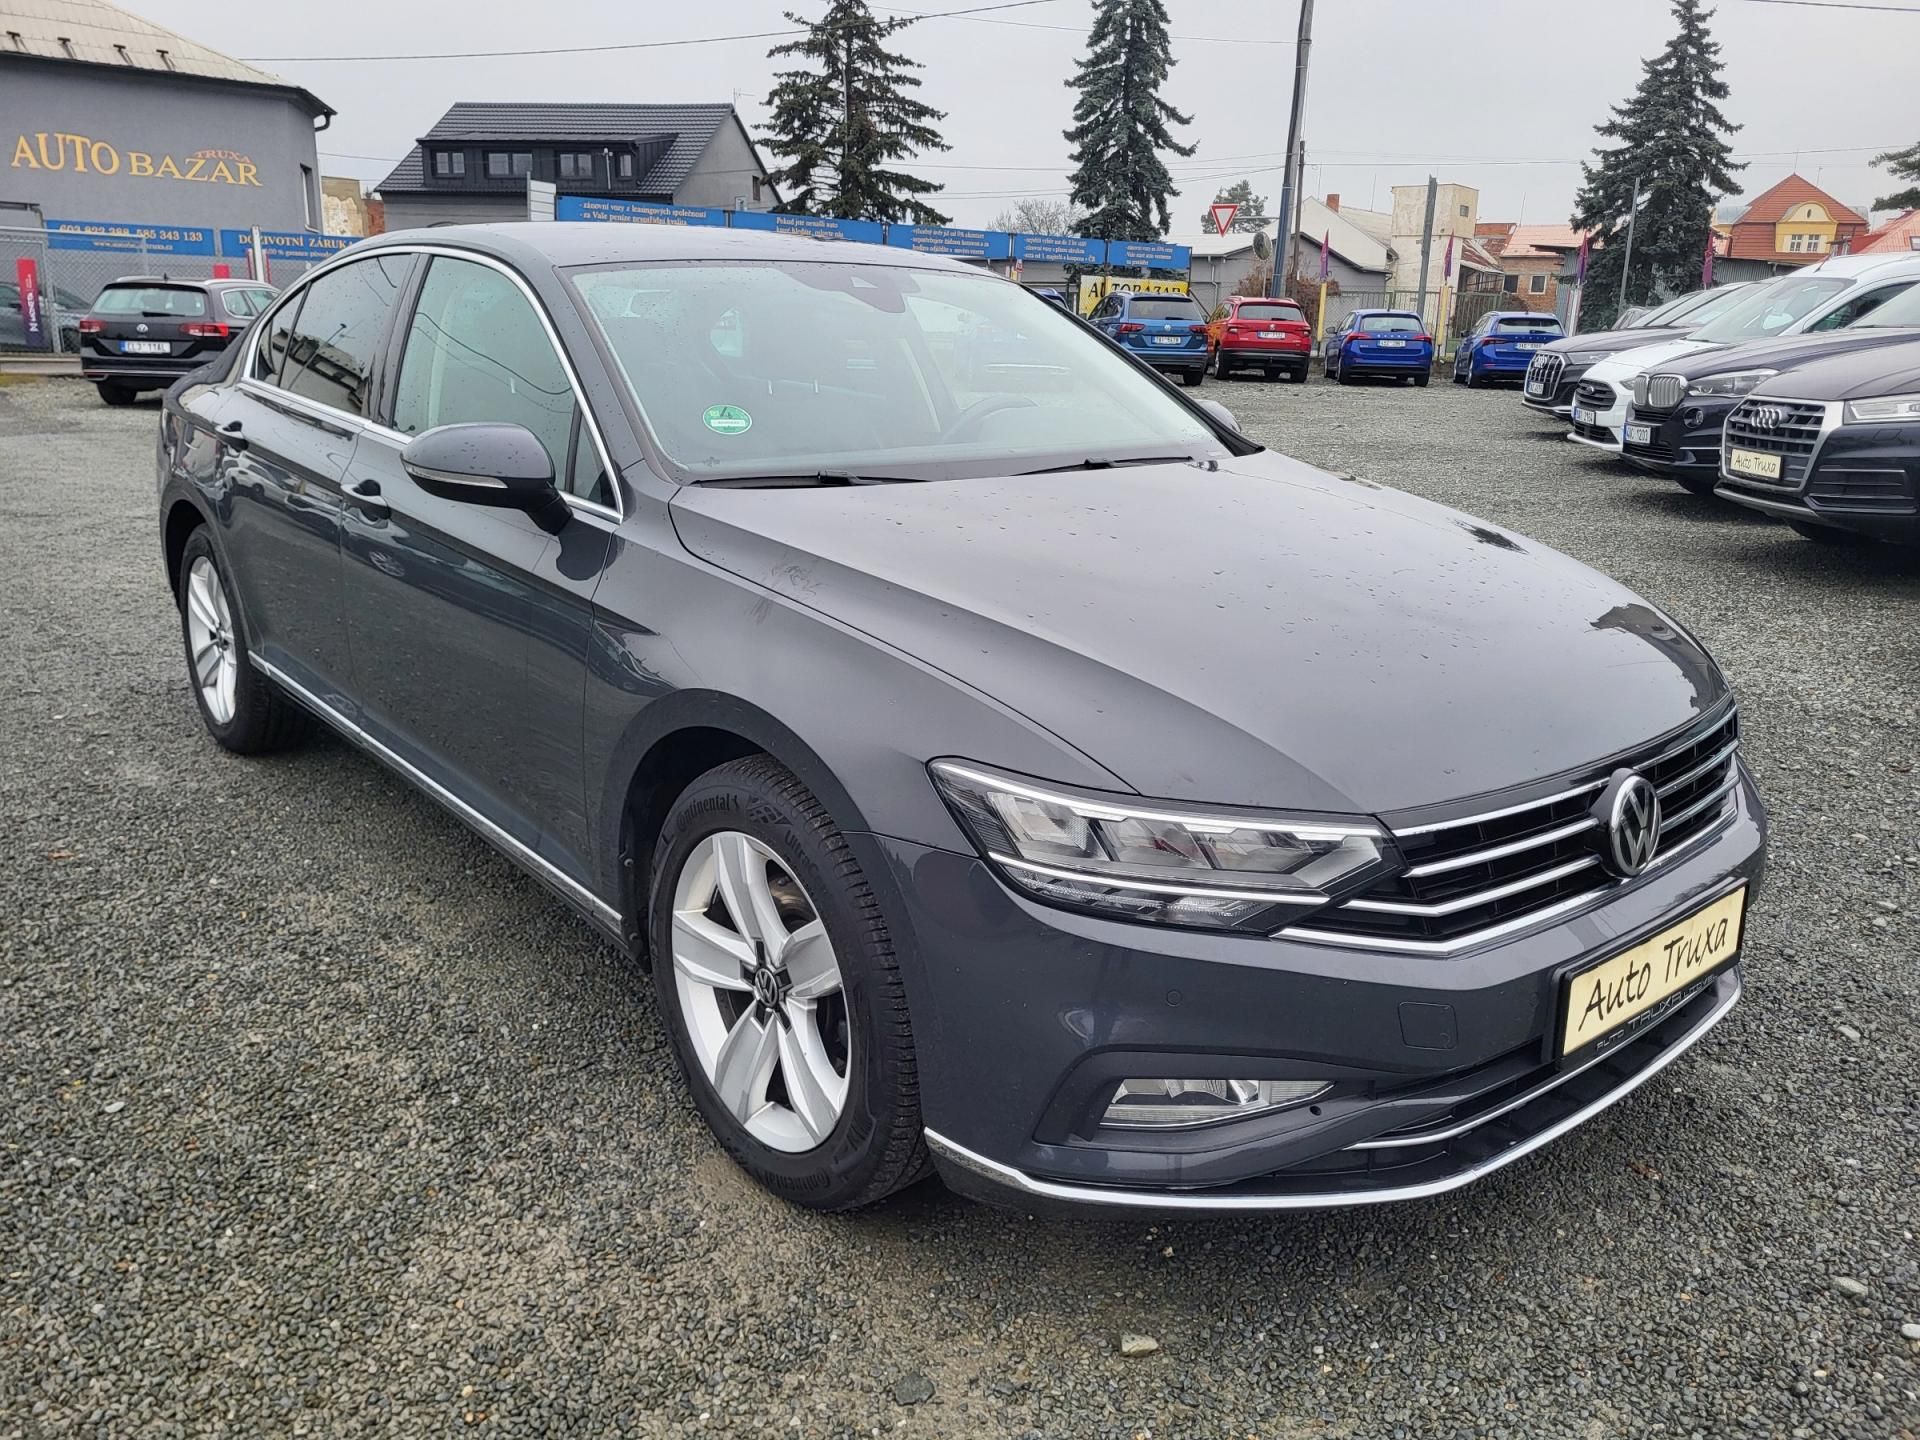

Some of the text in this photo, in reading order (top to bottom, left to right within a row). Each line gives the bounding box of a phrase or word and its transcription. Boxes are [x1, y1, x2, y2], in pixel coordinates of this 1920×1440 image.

[11, 132, 263, 186] AUTO BAZAR
[194, 150, 251, 163] TRUXA
[183, 231, 203, 242] 133
[1753, 457, 1777, 473] Truxa
[676, 793, 730, 832] Continental
[1578, 918, 1728, 1032] Auto Truxa
[1596, 1029, 1625, 1052] AUTO
[1628, 991, 1682, 1030] TRUXA
